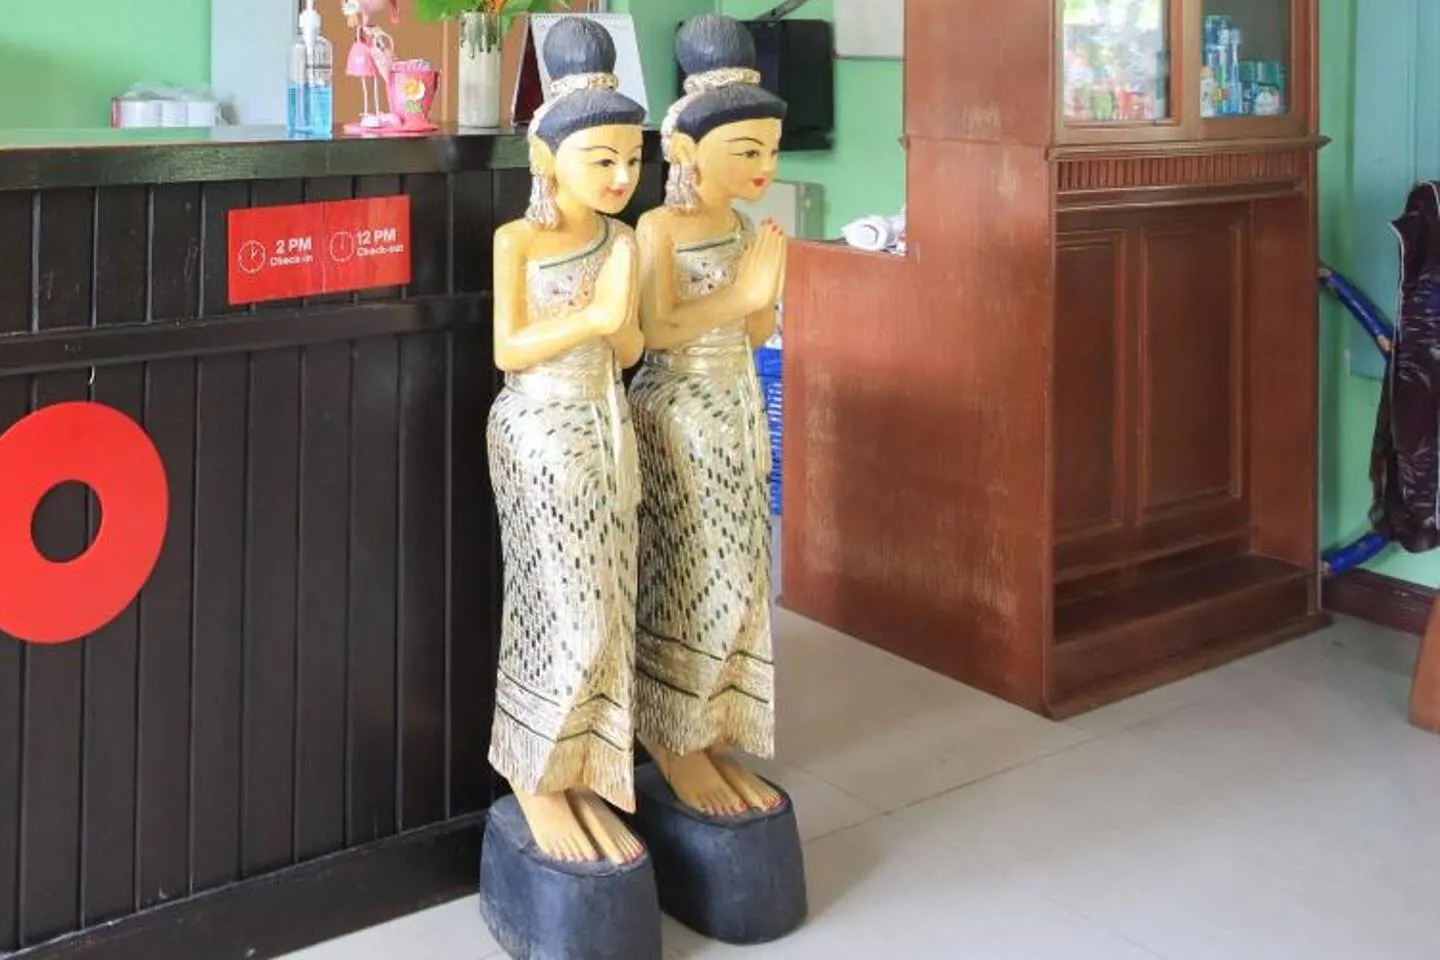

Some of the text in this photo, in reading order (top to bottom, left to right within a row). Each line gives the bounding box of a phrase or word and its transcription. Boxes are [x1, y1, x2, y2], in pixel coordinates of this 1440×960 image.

[275, 236, 312, 255] 2 PM
[356, 227, 396, 246] 12 PM
